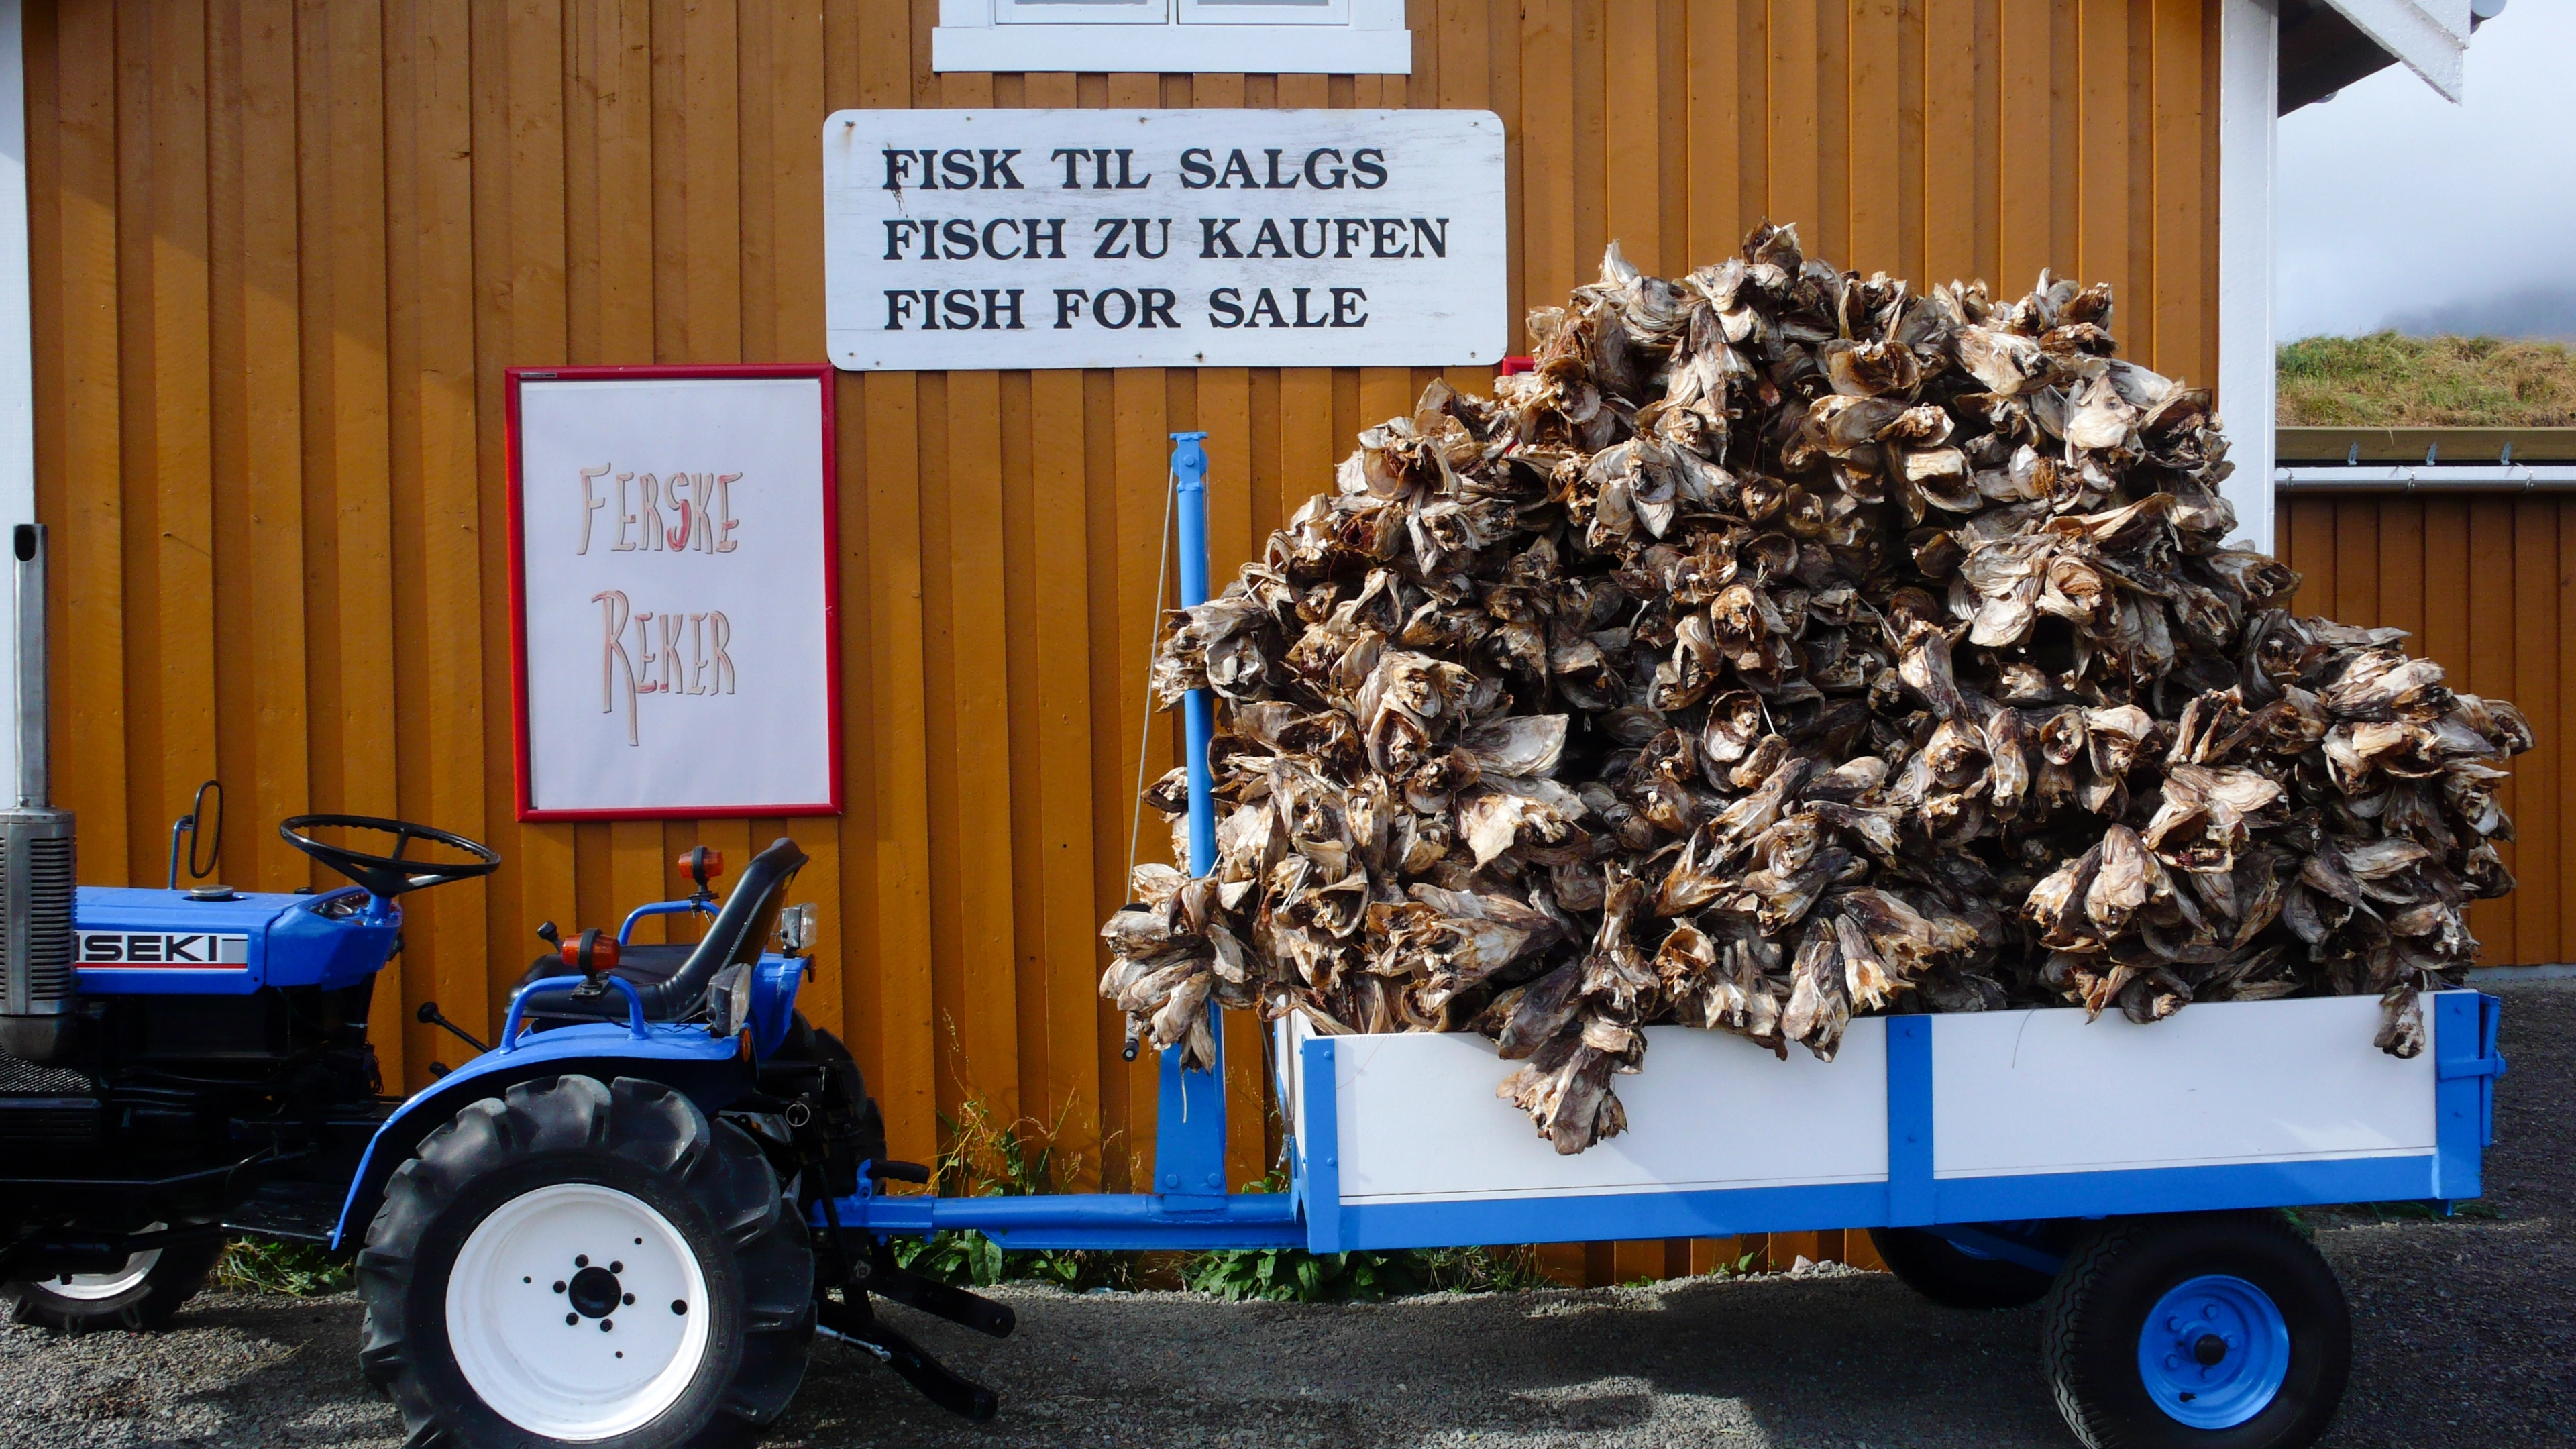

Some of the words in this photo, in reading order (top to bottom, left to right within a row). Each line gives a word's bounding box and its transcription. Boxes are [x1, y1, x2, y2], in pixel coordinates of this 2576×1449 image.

[882, 148, 1024, 190] FISK
[1051, 148, 1151, 189] TIL
[1179, 148, 1388, 190] SALGS
[883, 218, 1067, 260] FISCH
[1093, 218, 1172, 260] ZU
[1199, 217, 1450, 259] KAUFEN
[883, 288, 1025, 331] FISH
[1053, 288, 1181, 329] FOR
[1208, 288, 1369, 329] SALE
[577, 462, 743, 555] FERSKE
[591, 589, 735, 747] REKER
